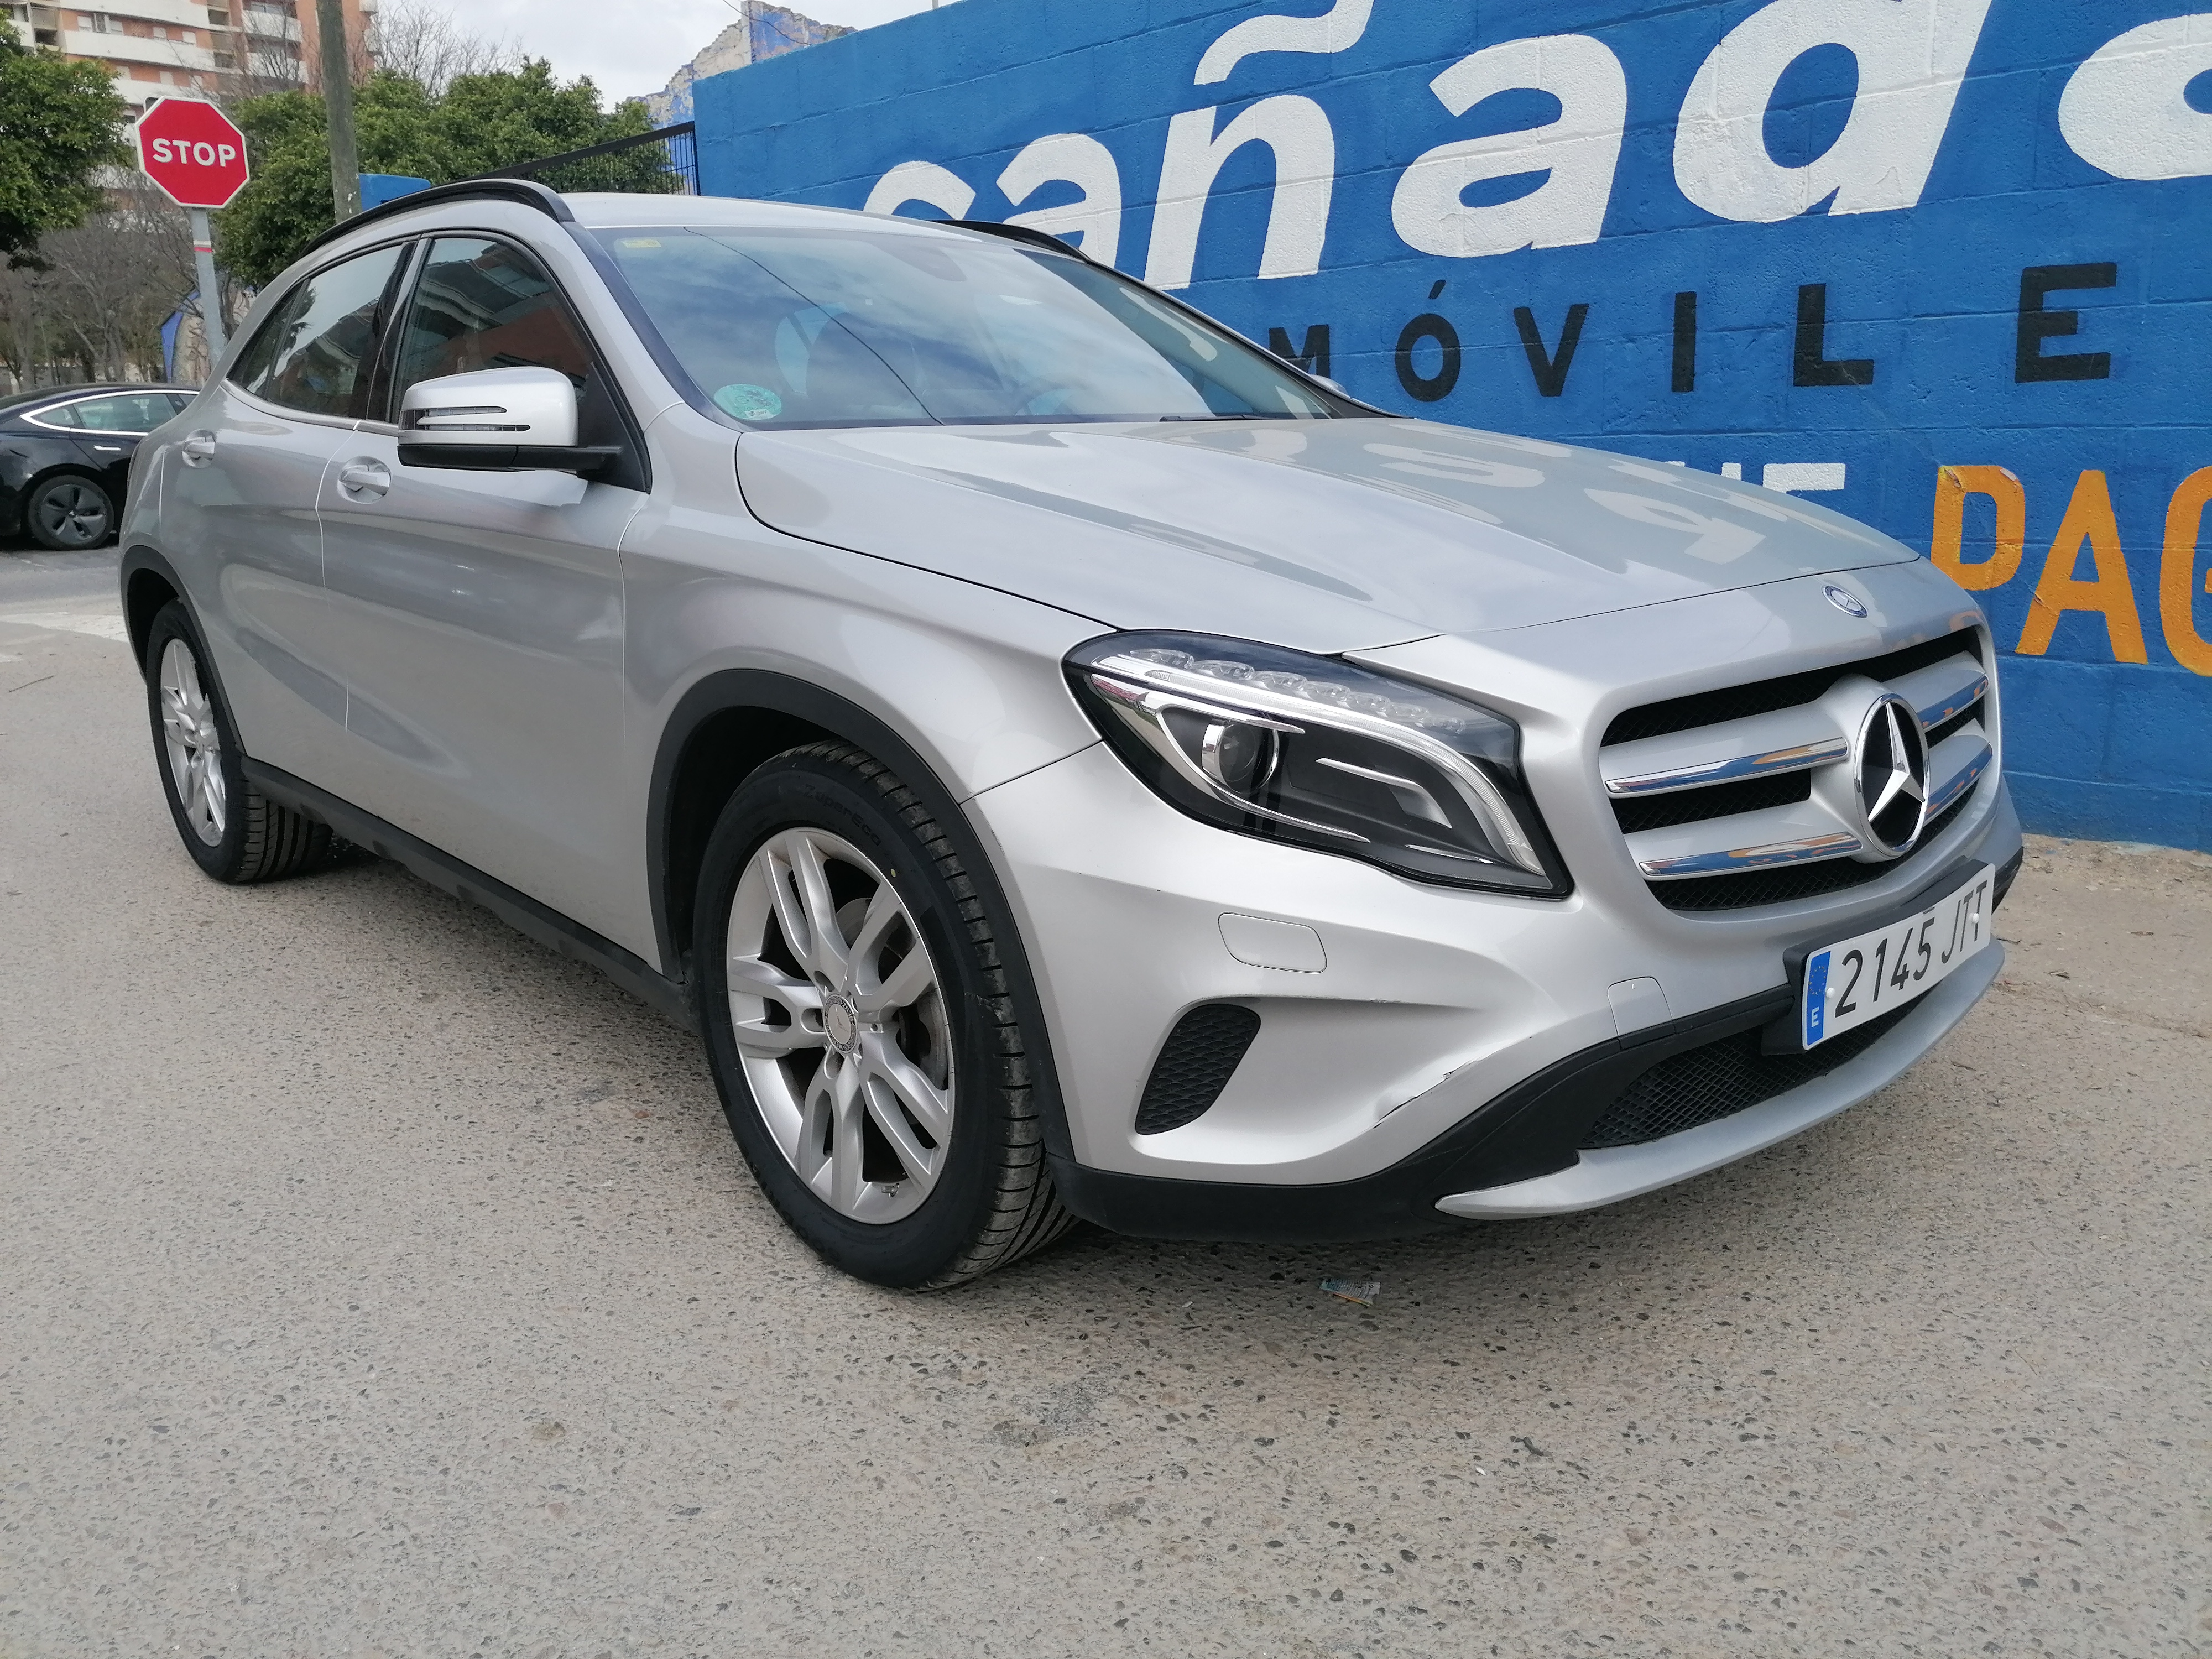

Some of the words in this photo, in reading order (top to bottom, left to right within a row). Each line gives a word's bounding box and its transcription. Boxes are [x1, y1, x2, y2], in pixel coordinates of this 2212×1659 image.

[152, 138, 236, 167] STOP
[1835, 916, 1935, 1018] 2145
[1941, 880, 1988, 964] JTT
[841, 1001, 854, 1022] BENZ
[1811, 1006, 1819, 1028] E
